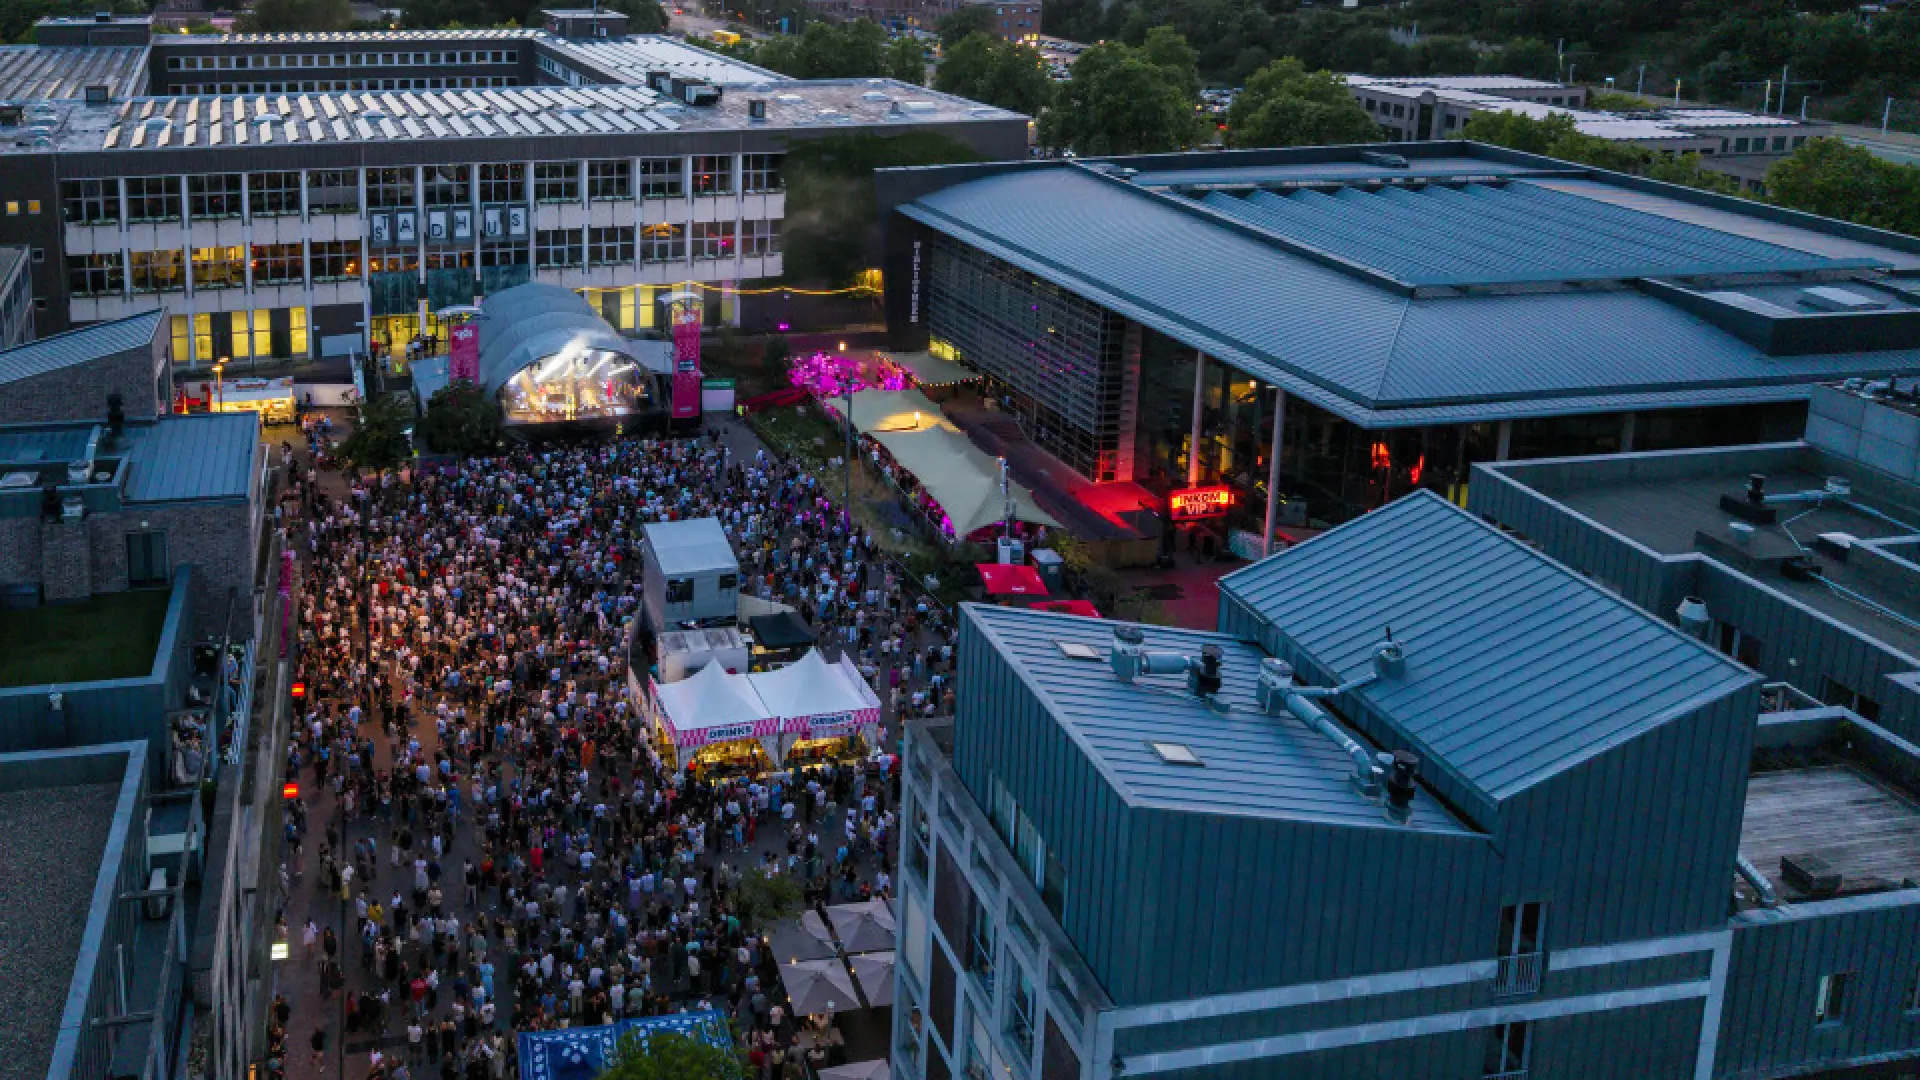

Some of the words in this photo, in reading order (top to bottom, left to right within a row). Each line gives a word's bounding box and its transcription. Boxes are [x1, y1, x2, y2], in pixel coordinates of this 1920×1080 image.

[1186, 502, 1207, 514] VIP
[808, 713, 853, 726] DRINKS
[709, 725, 753, 739] DRINKS
